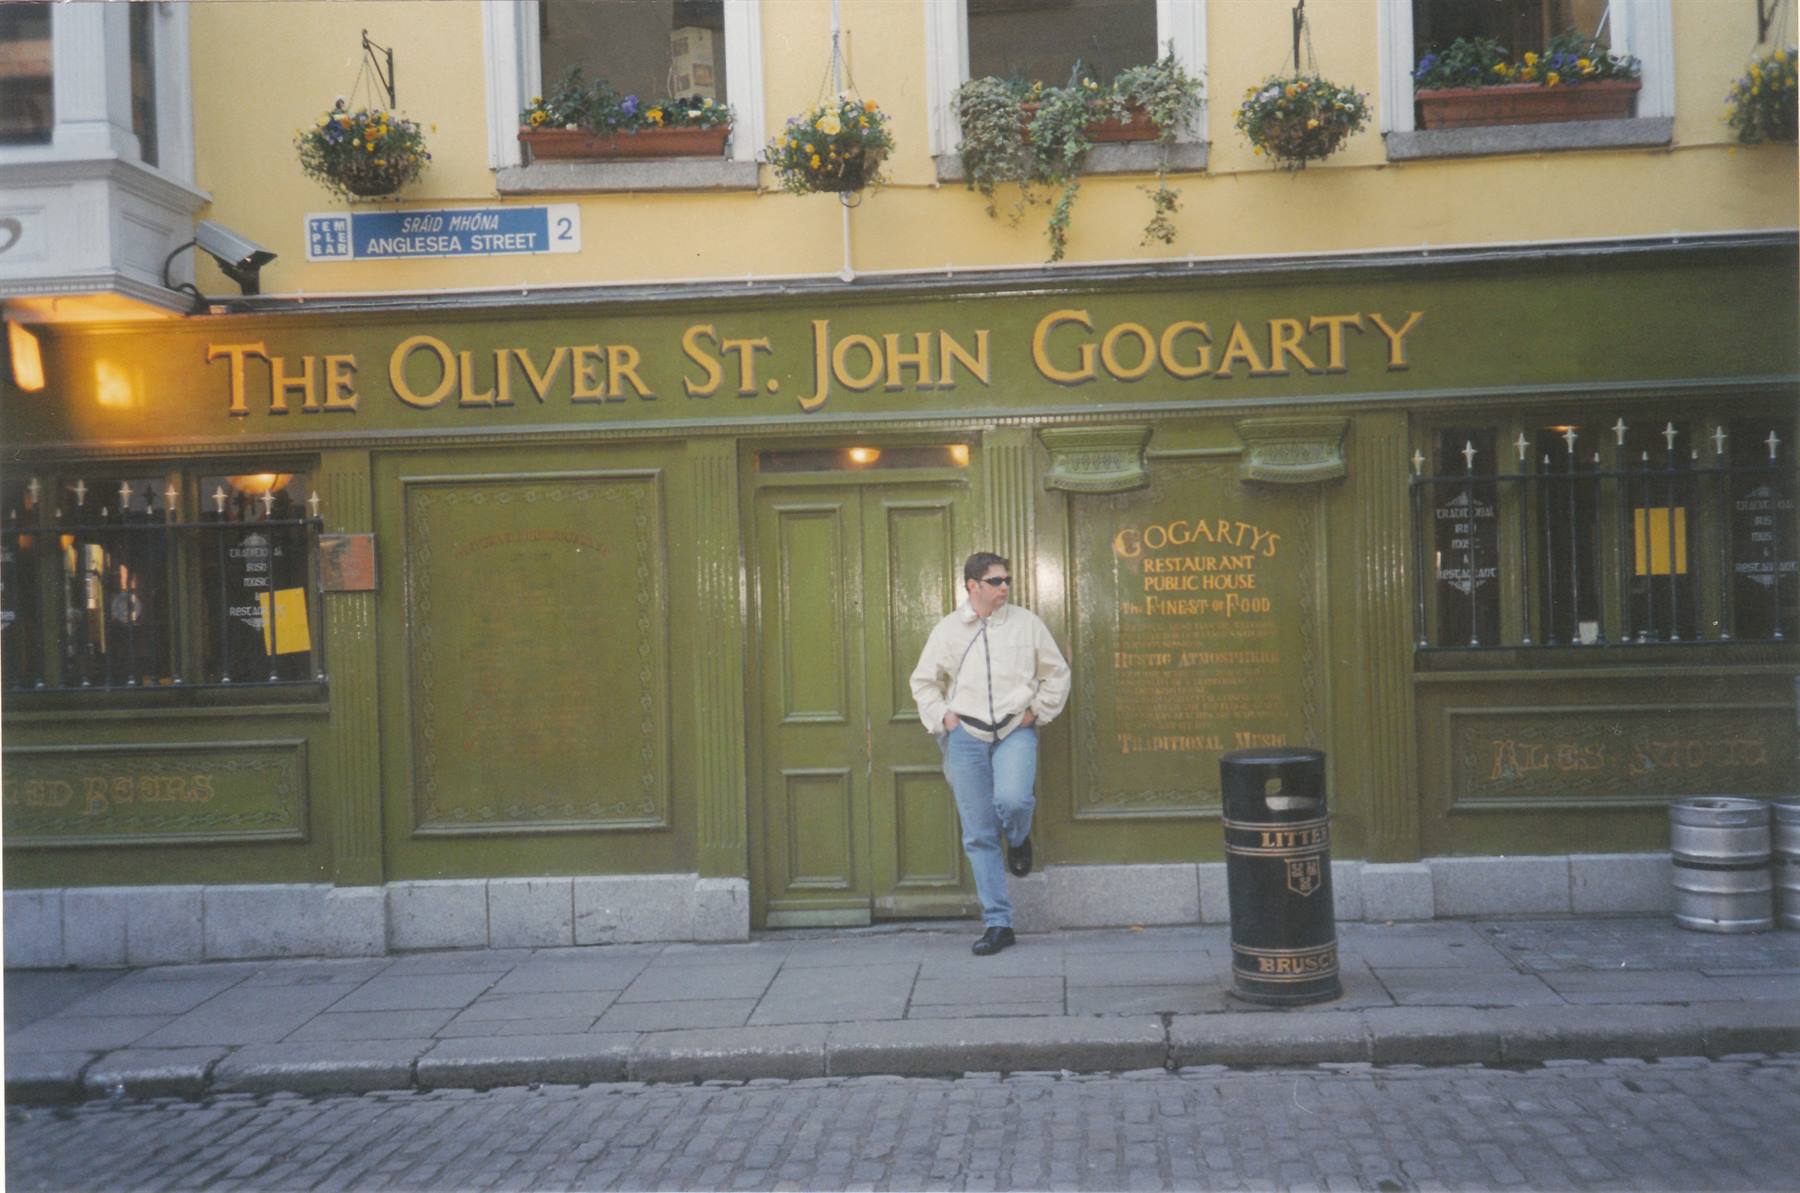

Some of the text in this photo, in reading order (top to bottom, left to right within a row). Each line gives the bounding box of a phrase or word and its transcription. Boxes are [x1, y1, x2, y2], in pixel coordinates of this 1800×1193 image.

[402, 212, 499, 232] SRÁID MHÓNA
[556, 217, 573, 241] 2
[367, 232, 537, 254] ANGLESEA STREET
[206, 308, 1424, 416] THE OLIVER ST. JOHN GOGARTY
[1113, 518, 1281, 558] GOGARTYS
[1143, 554, 1256, 573] RESTAURANT
[1143, 573, 1257, 592] PUBLIC HOUSE
